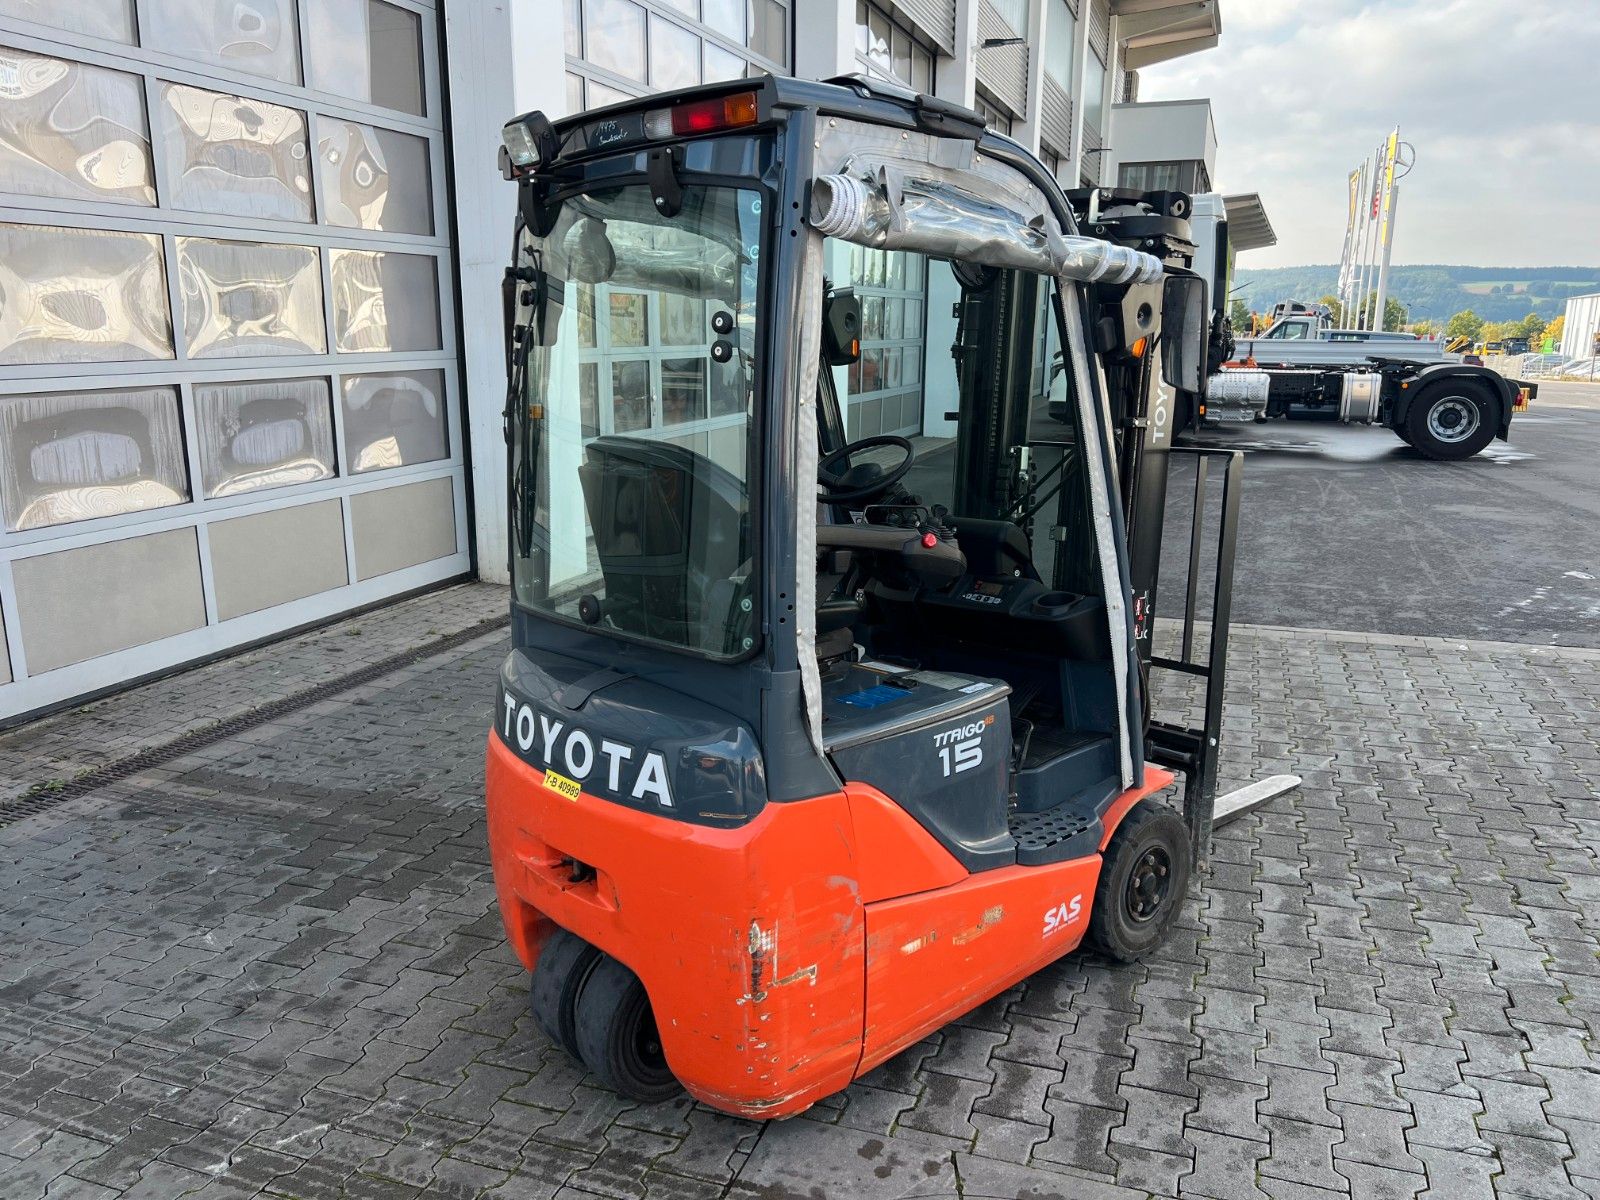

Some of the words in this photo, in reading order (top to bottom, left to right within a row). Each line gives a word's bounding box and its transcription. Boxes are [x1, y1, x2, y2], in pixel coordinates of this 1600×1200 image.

[504, 692, 673, 807] TOYOTA
[939, 737, 982, 777] 15
[1043, 893, 1082, 934] SAS
